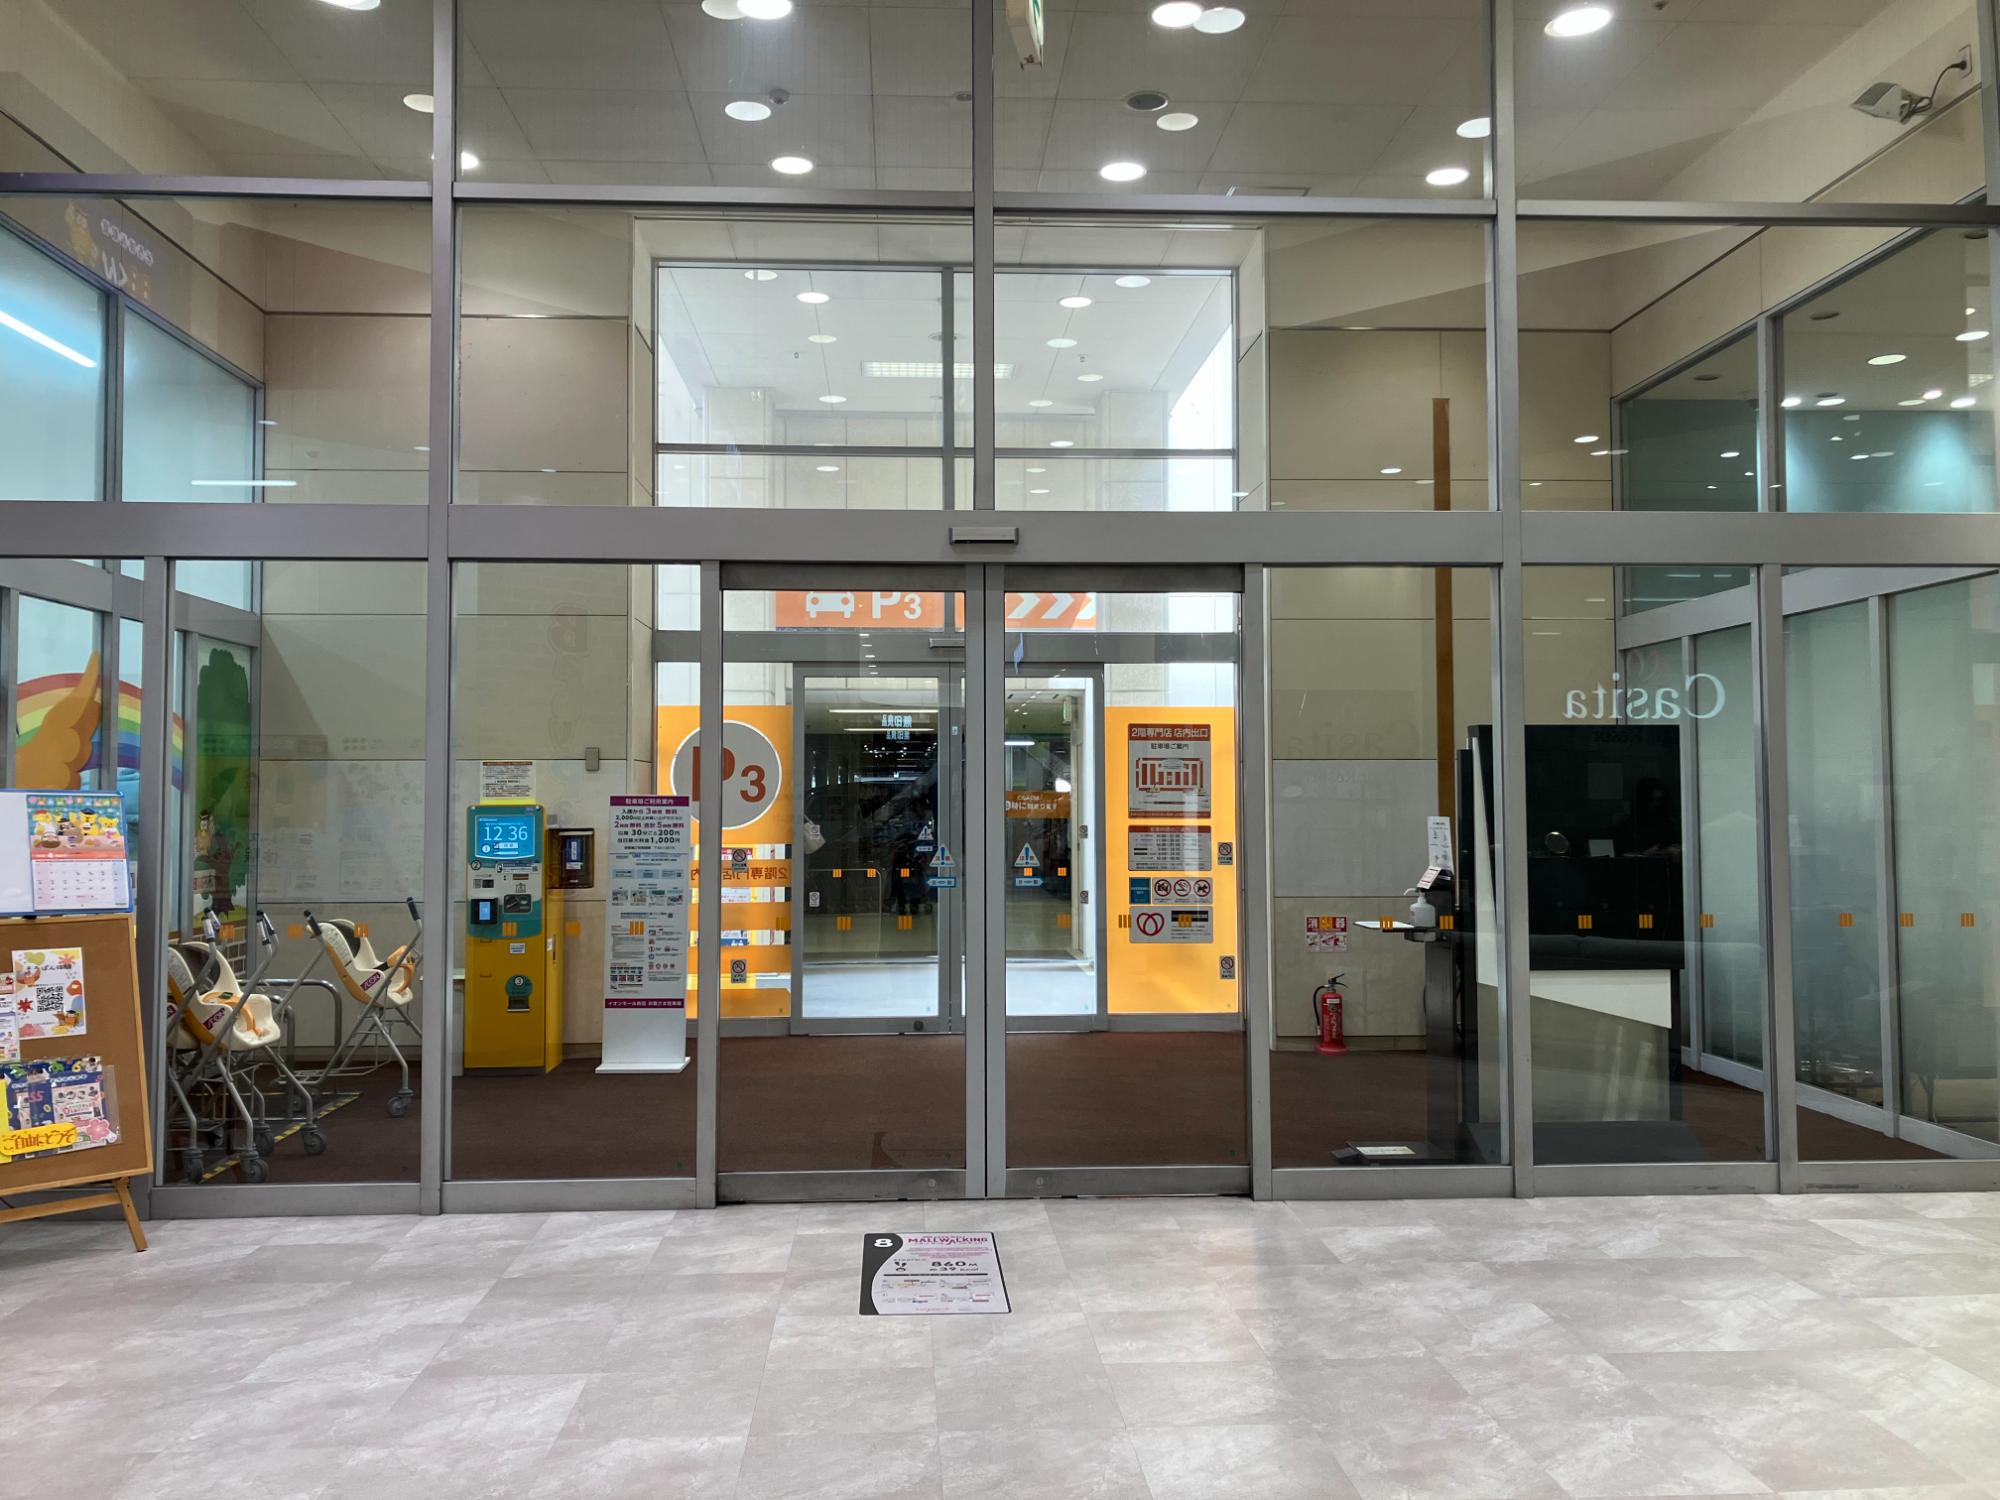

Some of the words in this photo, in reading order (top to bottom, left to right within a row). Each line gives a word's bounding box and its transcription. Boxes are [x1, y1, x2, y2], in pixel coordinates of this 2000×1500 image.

[872, 592, 922, 620] P3
[1131, 727, 1172, 738] 2階専門店
[1174, 727, 1208, 738] 店内出口
[1308, 917, 1345, 929] 消器
[874, 1238, 894, 1248] 8
